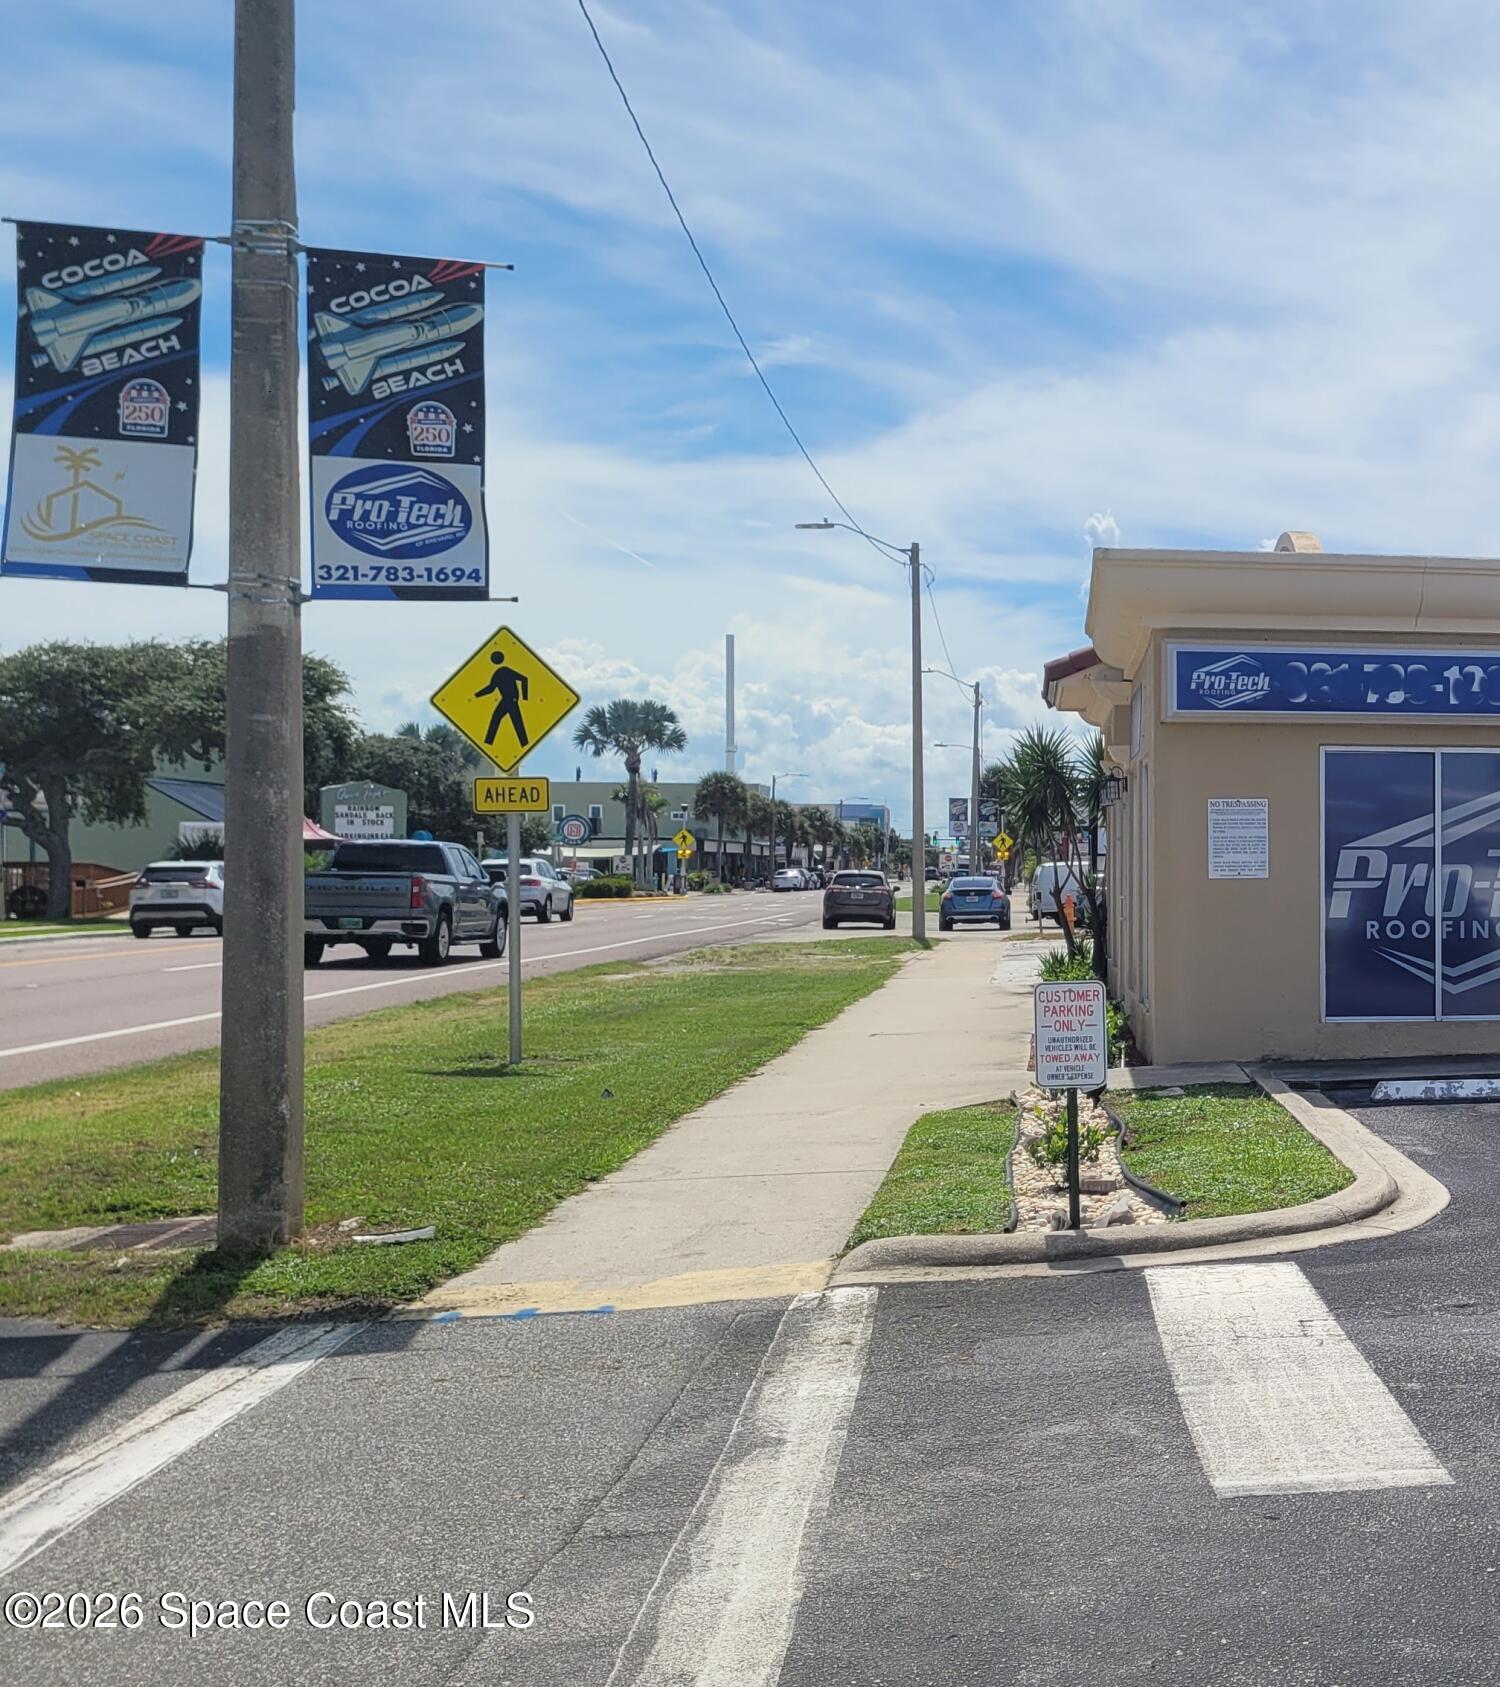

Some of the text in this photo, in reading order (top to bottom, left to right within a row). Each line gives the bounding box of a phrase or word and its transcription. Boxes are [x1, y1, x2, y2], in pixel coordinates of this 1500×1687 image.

[41, 248, 150, 289] COCOA
[330, 274, 432, 314] COCOA
[81, 334, 181, 377] BEACH
[372, 358, 465, 400] BEACH
[125, 405, 164, 423] 250
[413, 426, 451, 443] 250
[416, 445, 449, 453] FLORIDA
[328, 492, 465, 527] Pro-Tech
[346, 520, 409, 531] ROOFING
[134, 535, 178, 546] COAST
[317, 564, 482, 583] 321-783-1694
[1189, 671, 1272, 691] Pro-Tech
[1199, 688, 1237, 696] ROOFING
[484, 786, 540, 804] AHEAD
[1209, 800, 1267, 809] NO TRESPASSING
[1038, 989, 1100, 1003] CUSTOMER
[1043, 1004, 1094, 1018] PARKING
[1053, 1019, 1086, 1032] ONLY
[1047, 1035, 1094, 1044] UNAUTHORIZED
[1044, 1044, 1073, 1052] VEHICLES
[1073, 1043, 1088, 1051] WILL
[1040, 1052, 1101, 1064] TOWED AWAY
[1055, 1064, 1085, 1073] AT VEHICLE
[1046, 1072, 1094, 1081] OWNER'S EXPENSE
